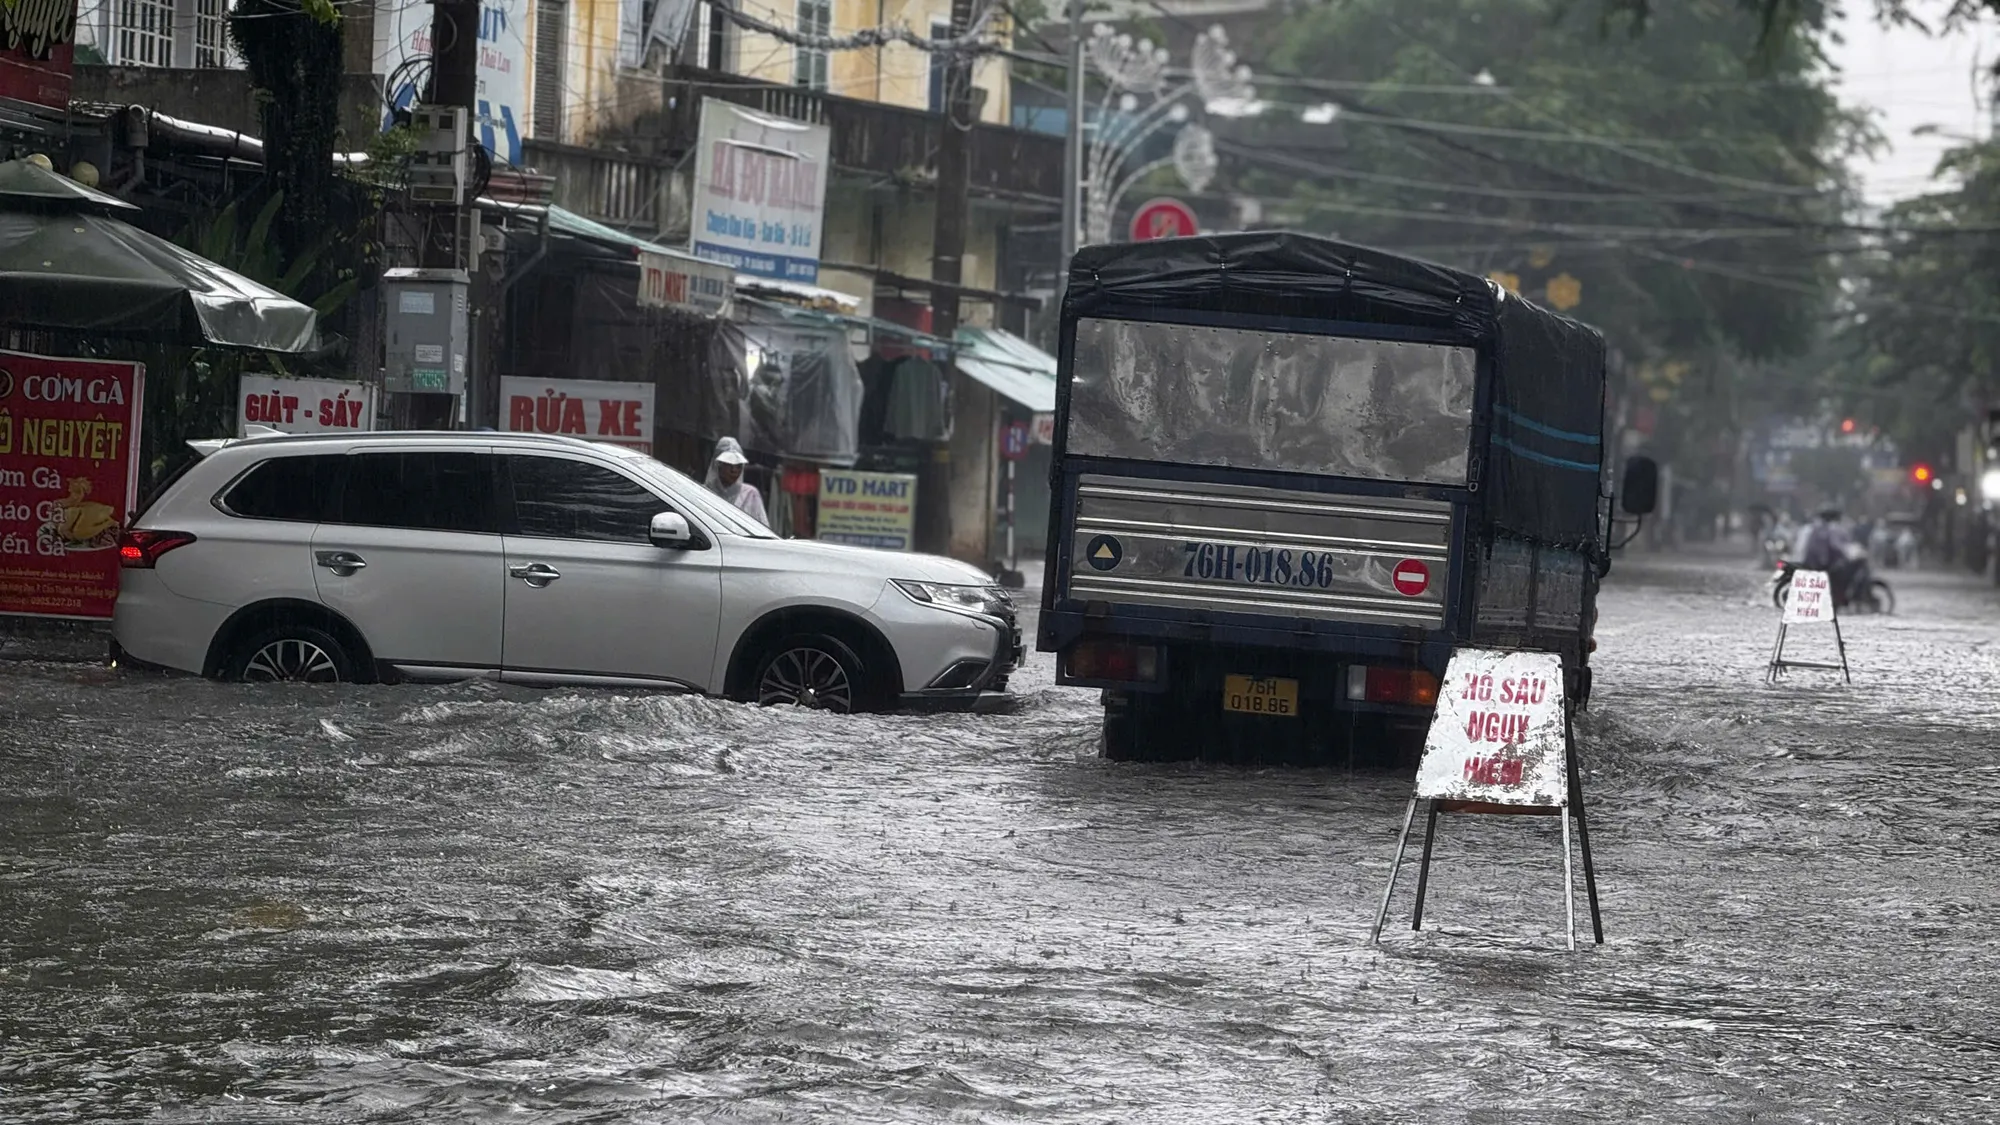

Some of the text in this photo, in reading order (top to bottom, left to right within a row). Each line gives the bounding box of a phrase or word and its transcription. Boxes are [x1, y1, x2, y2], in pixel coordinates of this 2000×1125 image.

[23, 372, 124, 405] CƠM GÀ
[245, 389, 299, 430] GIẶT
[319, 388, 363, 428] SẤY
[509, 388, 642, 436] RỬA XE
[22, 412, 123, 468] NGUYỆT
[31, 467, 61, 489] Gà
[825, 476, 910, 499] VTD MART
[36, 500, 66, 523] Gà
[36, 534, 66, 557] Gà
[1183, 541, 1333, 589] 76H-018.86
[1245, 679, 1277, 696] 76H
[1231, 694, 1289, 714] 018.86
[1466, 711, 1531, 744] NGUY
